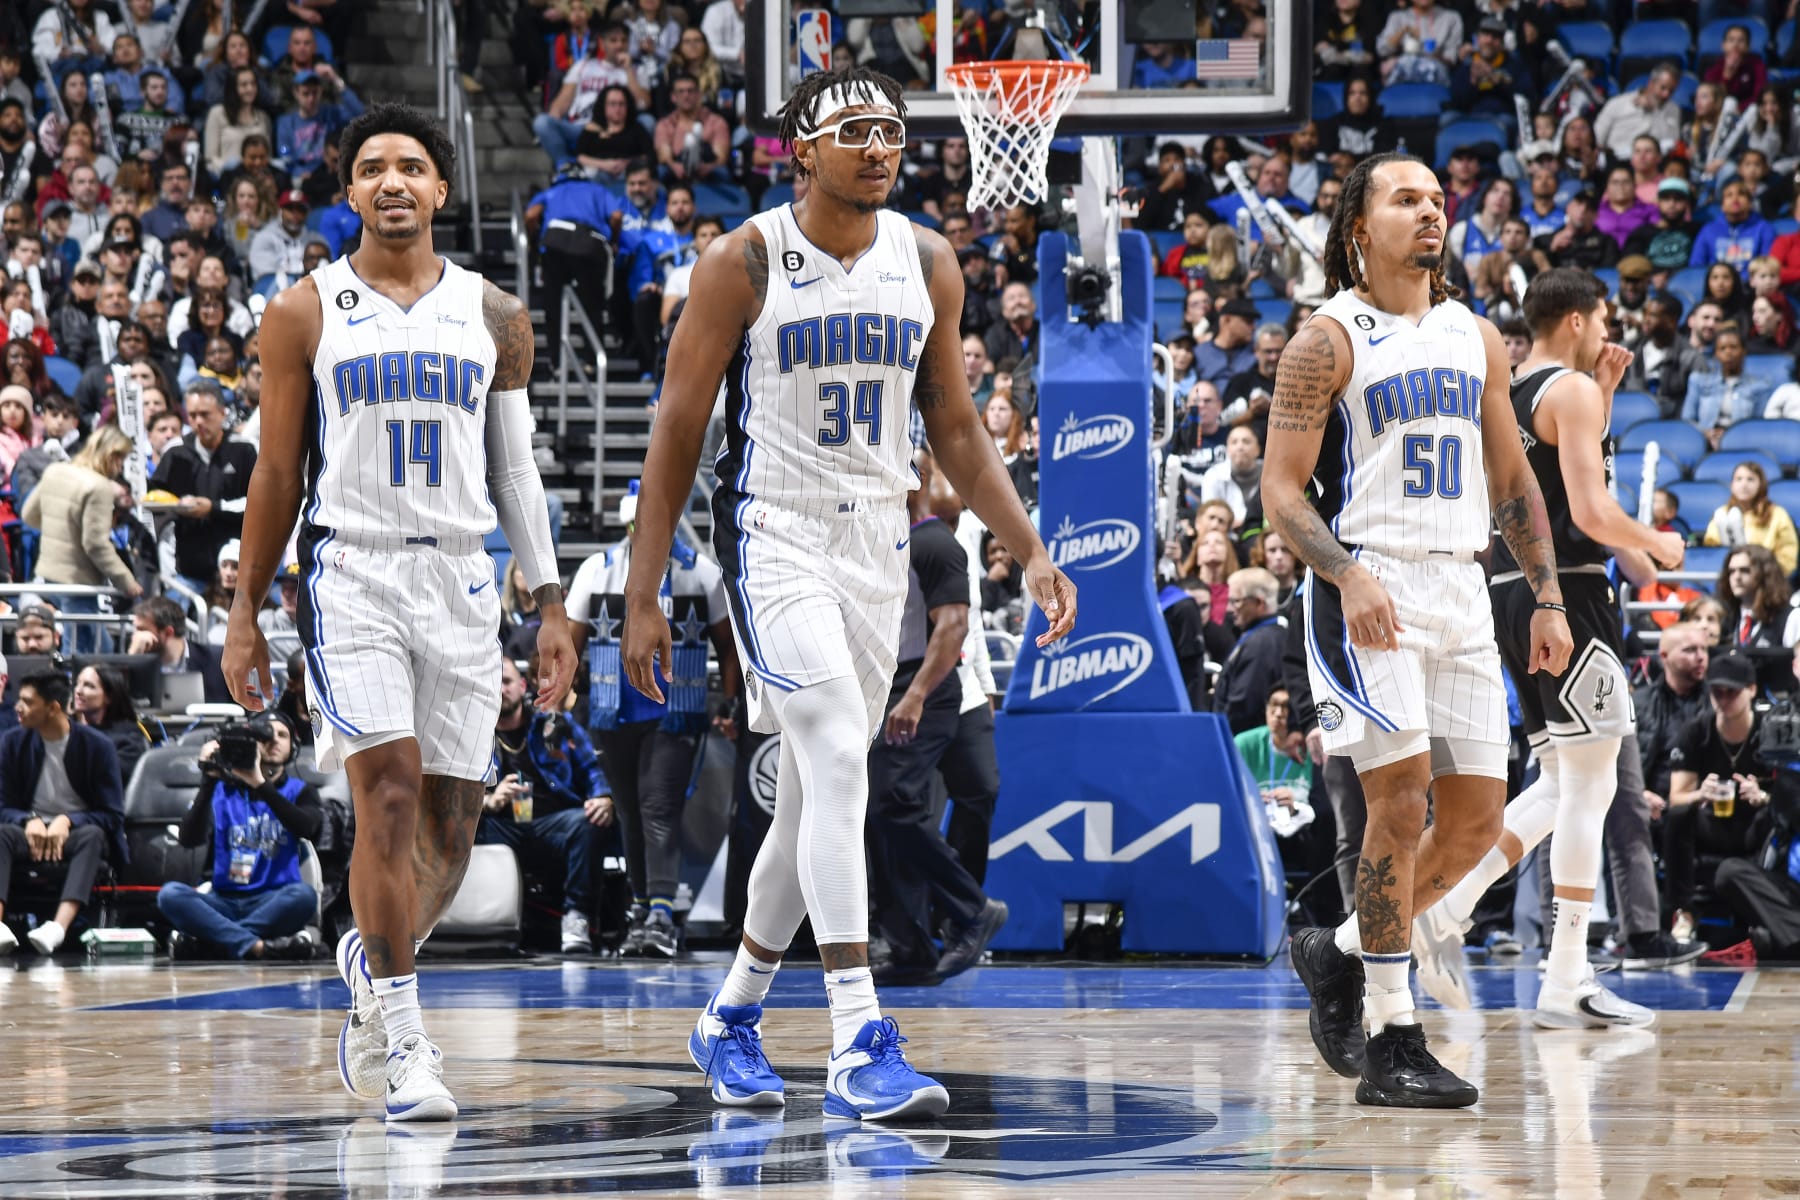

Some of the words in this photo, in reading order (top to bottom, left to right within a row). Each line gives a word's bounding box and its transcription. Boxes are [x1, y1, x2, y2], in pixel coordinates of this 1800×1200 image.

[786, 252, 799, 269] 6
[875, 271, 907, 285] Disney
[341, 291, 355, 308] 6
[434, 312, 467, 328] Disney
[1359, 316, 1373, 330] 6
[777, 312, 923, 374] MAGIC
[333, 351, 484, 417] MAGIC
[1364, 367, 1483, 438] MAGIC
[818, 380, 884, 446] 34
[1052, 421, 1127, 461] LIBMAN
[386, 420, 442, 487] 14
[1403, 434, 1463, 500] 50
[1048, 528, 1132, 568] LIBMAN
[1030, 644, 1141, 701] LIBMAN
[988, 800, 1221, 865] KIA
